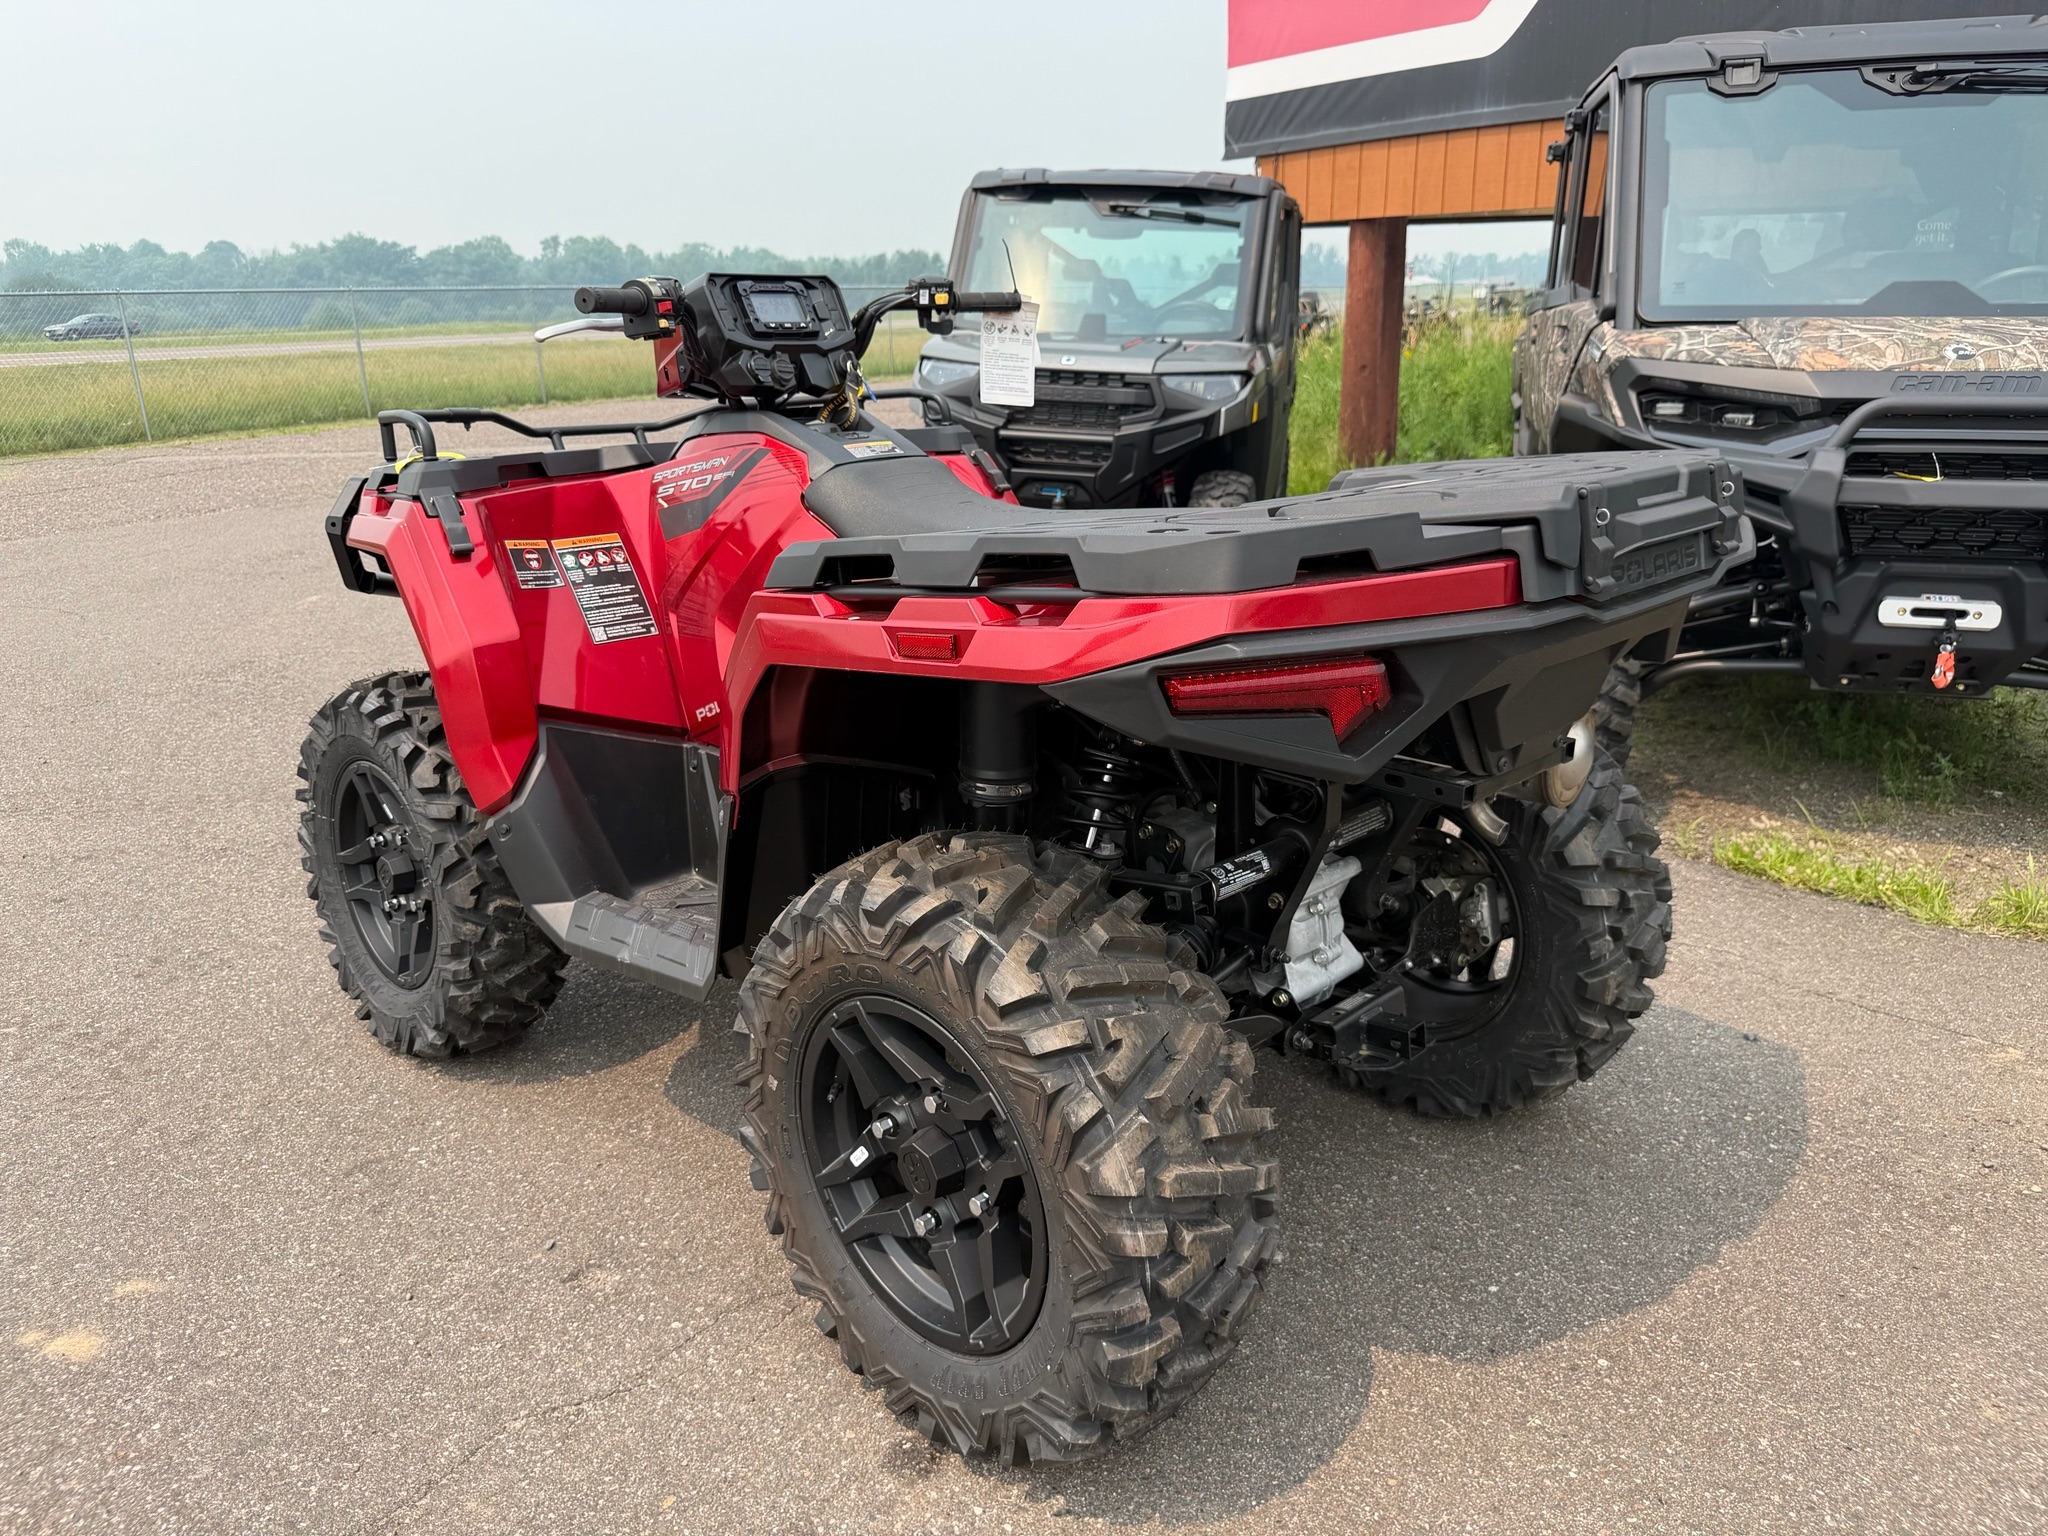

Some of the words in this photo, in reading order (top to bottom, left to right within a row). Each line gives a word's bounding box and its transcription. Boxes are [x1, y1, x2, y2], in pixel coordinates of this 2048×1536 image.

[1917, 219, 1952, 231] Come
[1915, 233, 1935, 244] get
[1936, 231, 1948, 242] it.
[652, 456, 730, 483] SPORTSMAN
[656, 474, 713, 498] 570
[1611, 544, 1697, 584] POLARIS
[695, 701, 720, 722] POL
